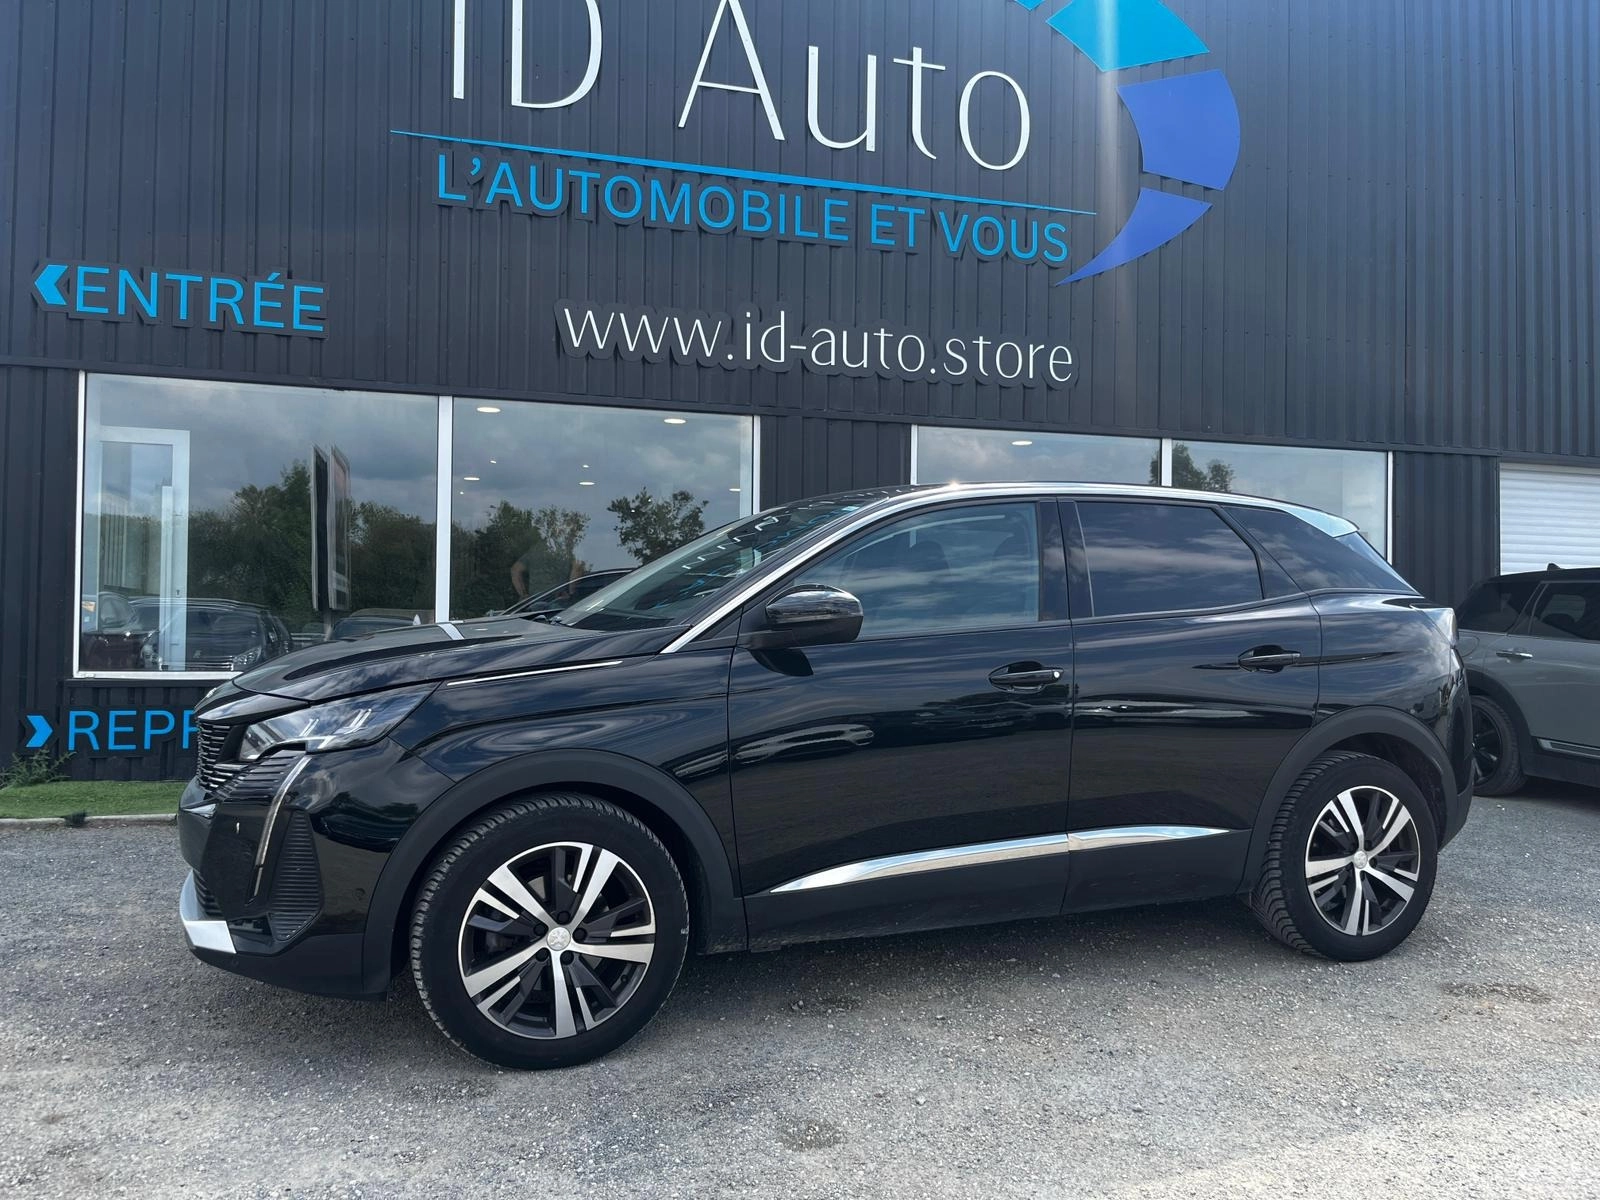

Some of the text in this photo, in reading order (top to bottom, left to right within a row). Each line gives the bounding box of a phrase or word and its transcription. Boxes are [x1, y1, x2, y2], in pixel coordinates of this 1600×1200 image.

[678, 0, 1032, 171] Auto
[869, 201, 927, 250] ET
[939, 209, 1070, 265] VOUS
[75, 264, 324, 332] ENTRÉE
[563, 308, 1074, 383] www.id-auto.store
